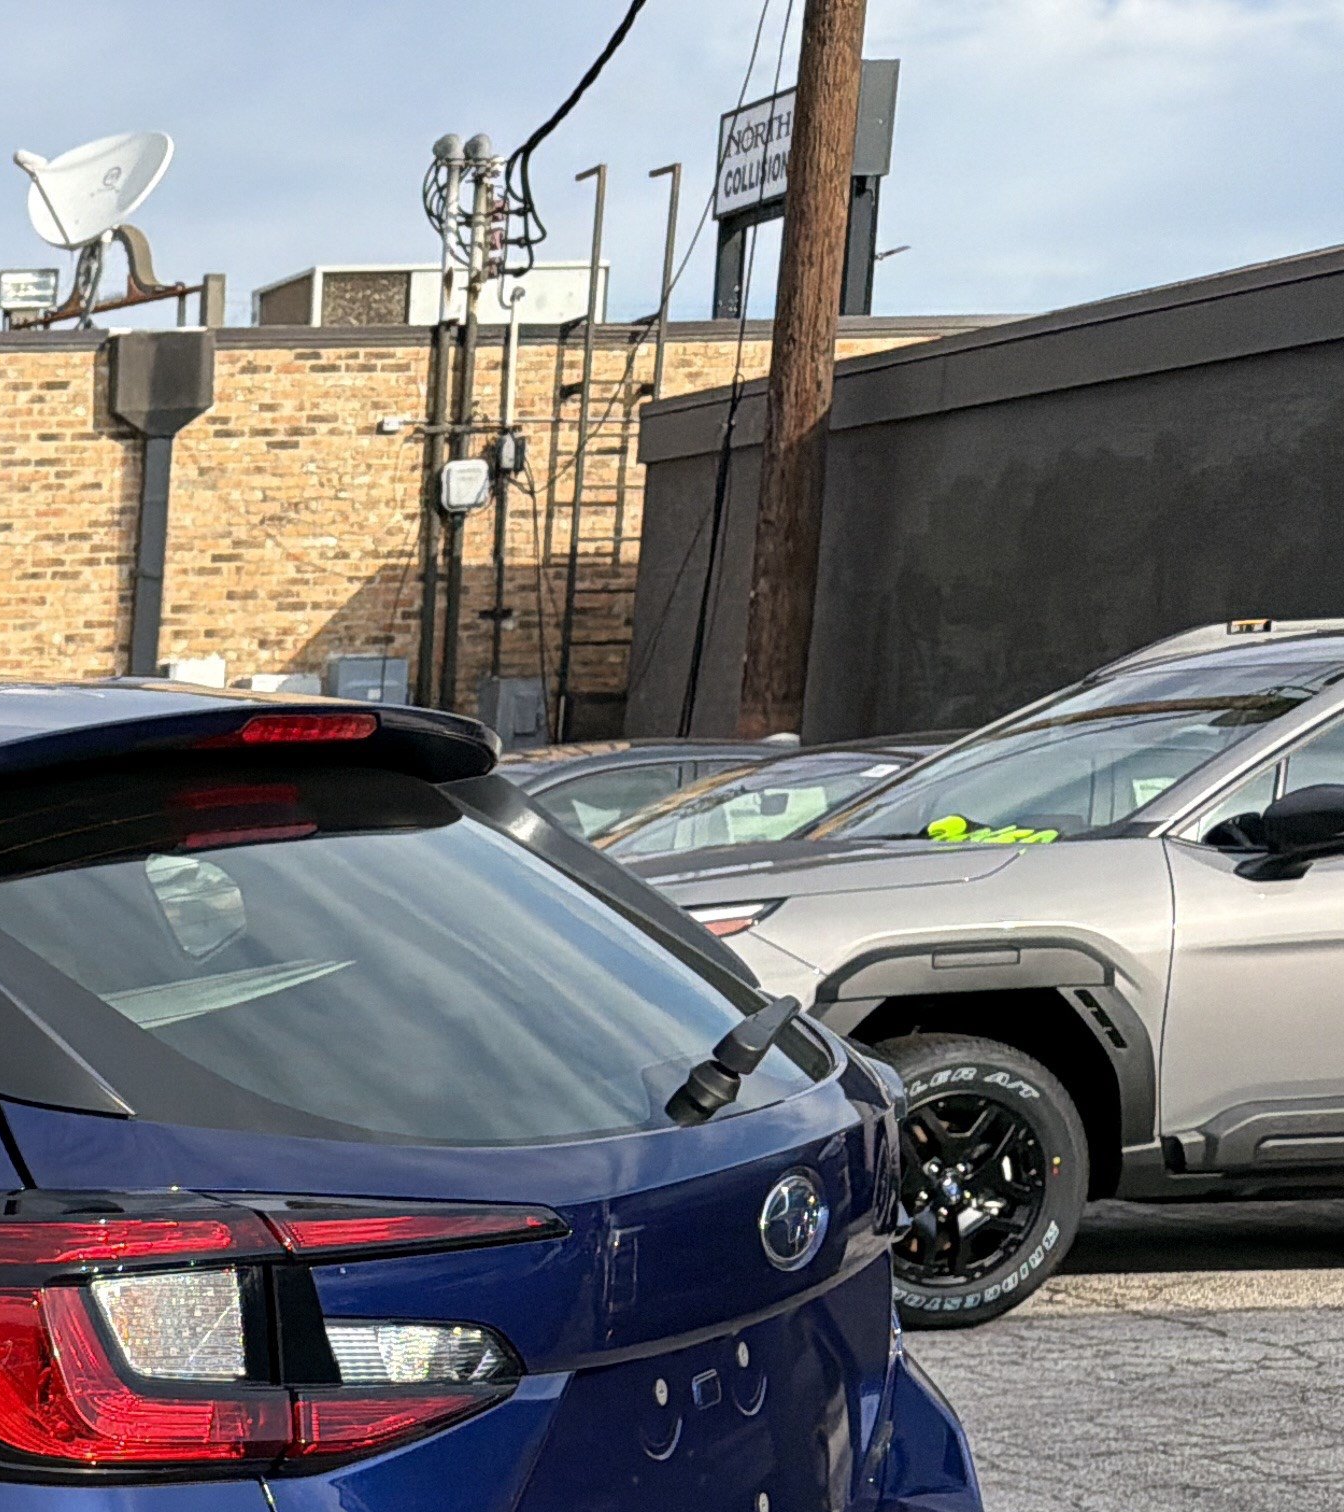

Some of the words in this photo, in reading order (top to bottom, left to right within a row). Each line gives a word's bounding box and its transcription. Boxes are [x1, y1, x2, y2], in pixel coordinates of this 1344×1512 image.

[726, 110, 791, 158] NORTH
[724, 150, 790, 197] COLLIION
[892, 1220, 1060, 1311] BRIDGESTON
